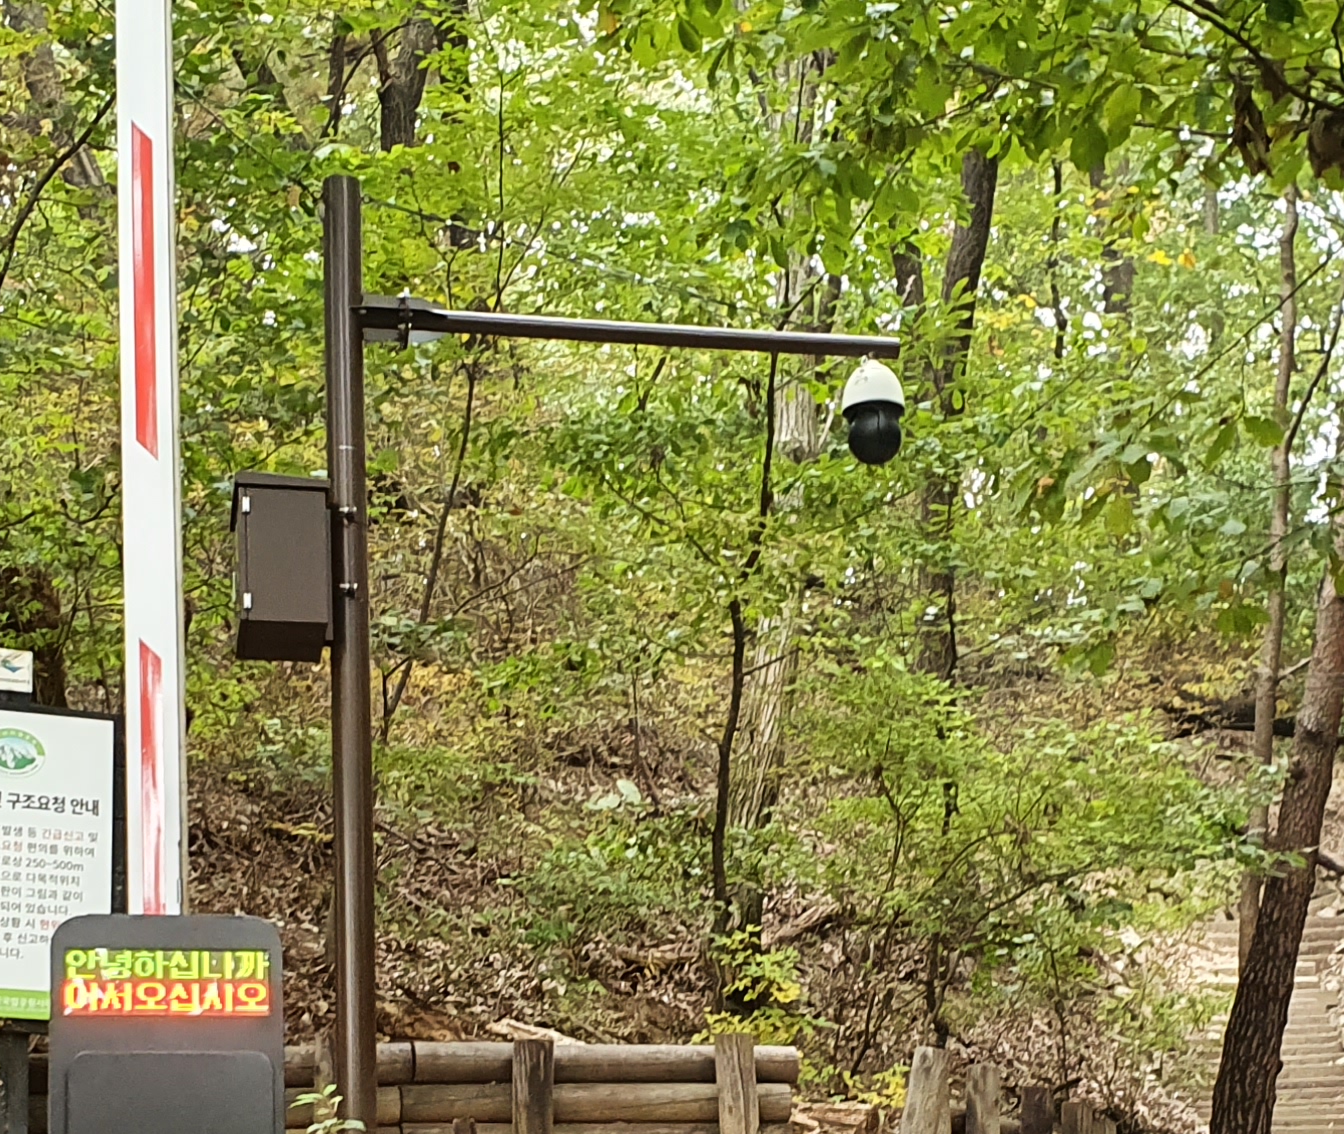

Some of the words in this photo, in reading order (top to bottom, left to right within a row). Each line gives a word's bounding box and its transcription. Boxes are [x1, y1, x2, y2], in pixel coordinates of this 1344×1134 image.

[6, 792, 66, 813] 구조요청
[70, 798, 99, 816] 안내
[27, 827, 37, 838] 등
[42, 828, 84, 841] 긴급신고
[88, 831, 98, 842] 및
[27, 842, 59, 855] 편의를
[63, 845, 95, 858] 위하여
[26, 872, 80, 887] 다목적위치
[26, 888, 58, 900] 그림과
[62, 891, 83, 902] 같이
[25, 918, 36, 929] 시
[3, 932, 12, 942] 후
[64, 949, 269, 980] 안녕하십니까
[63, 981, 269, 1012] 어서오십시오
